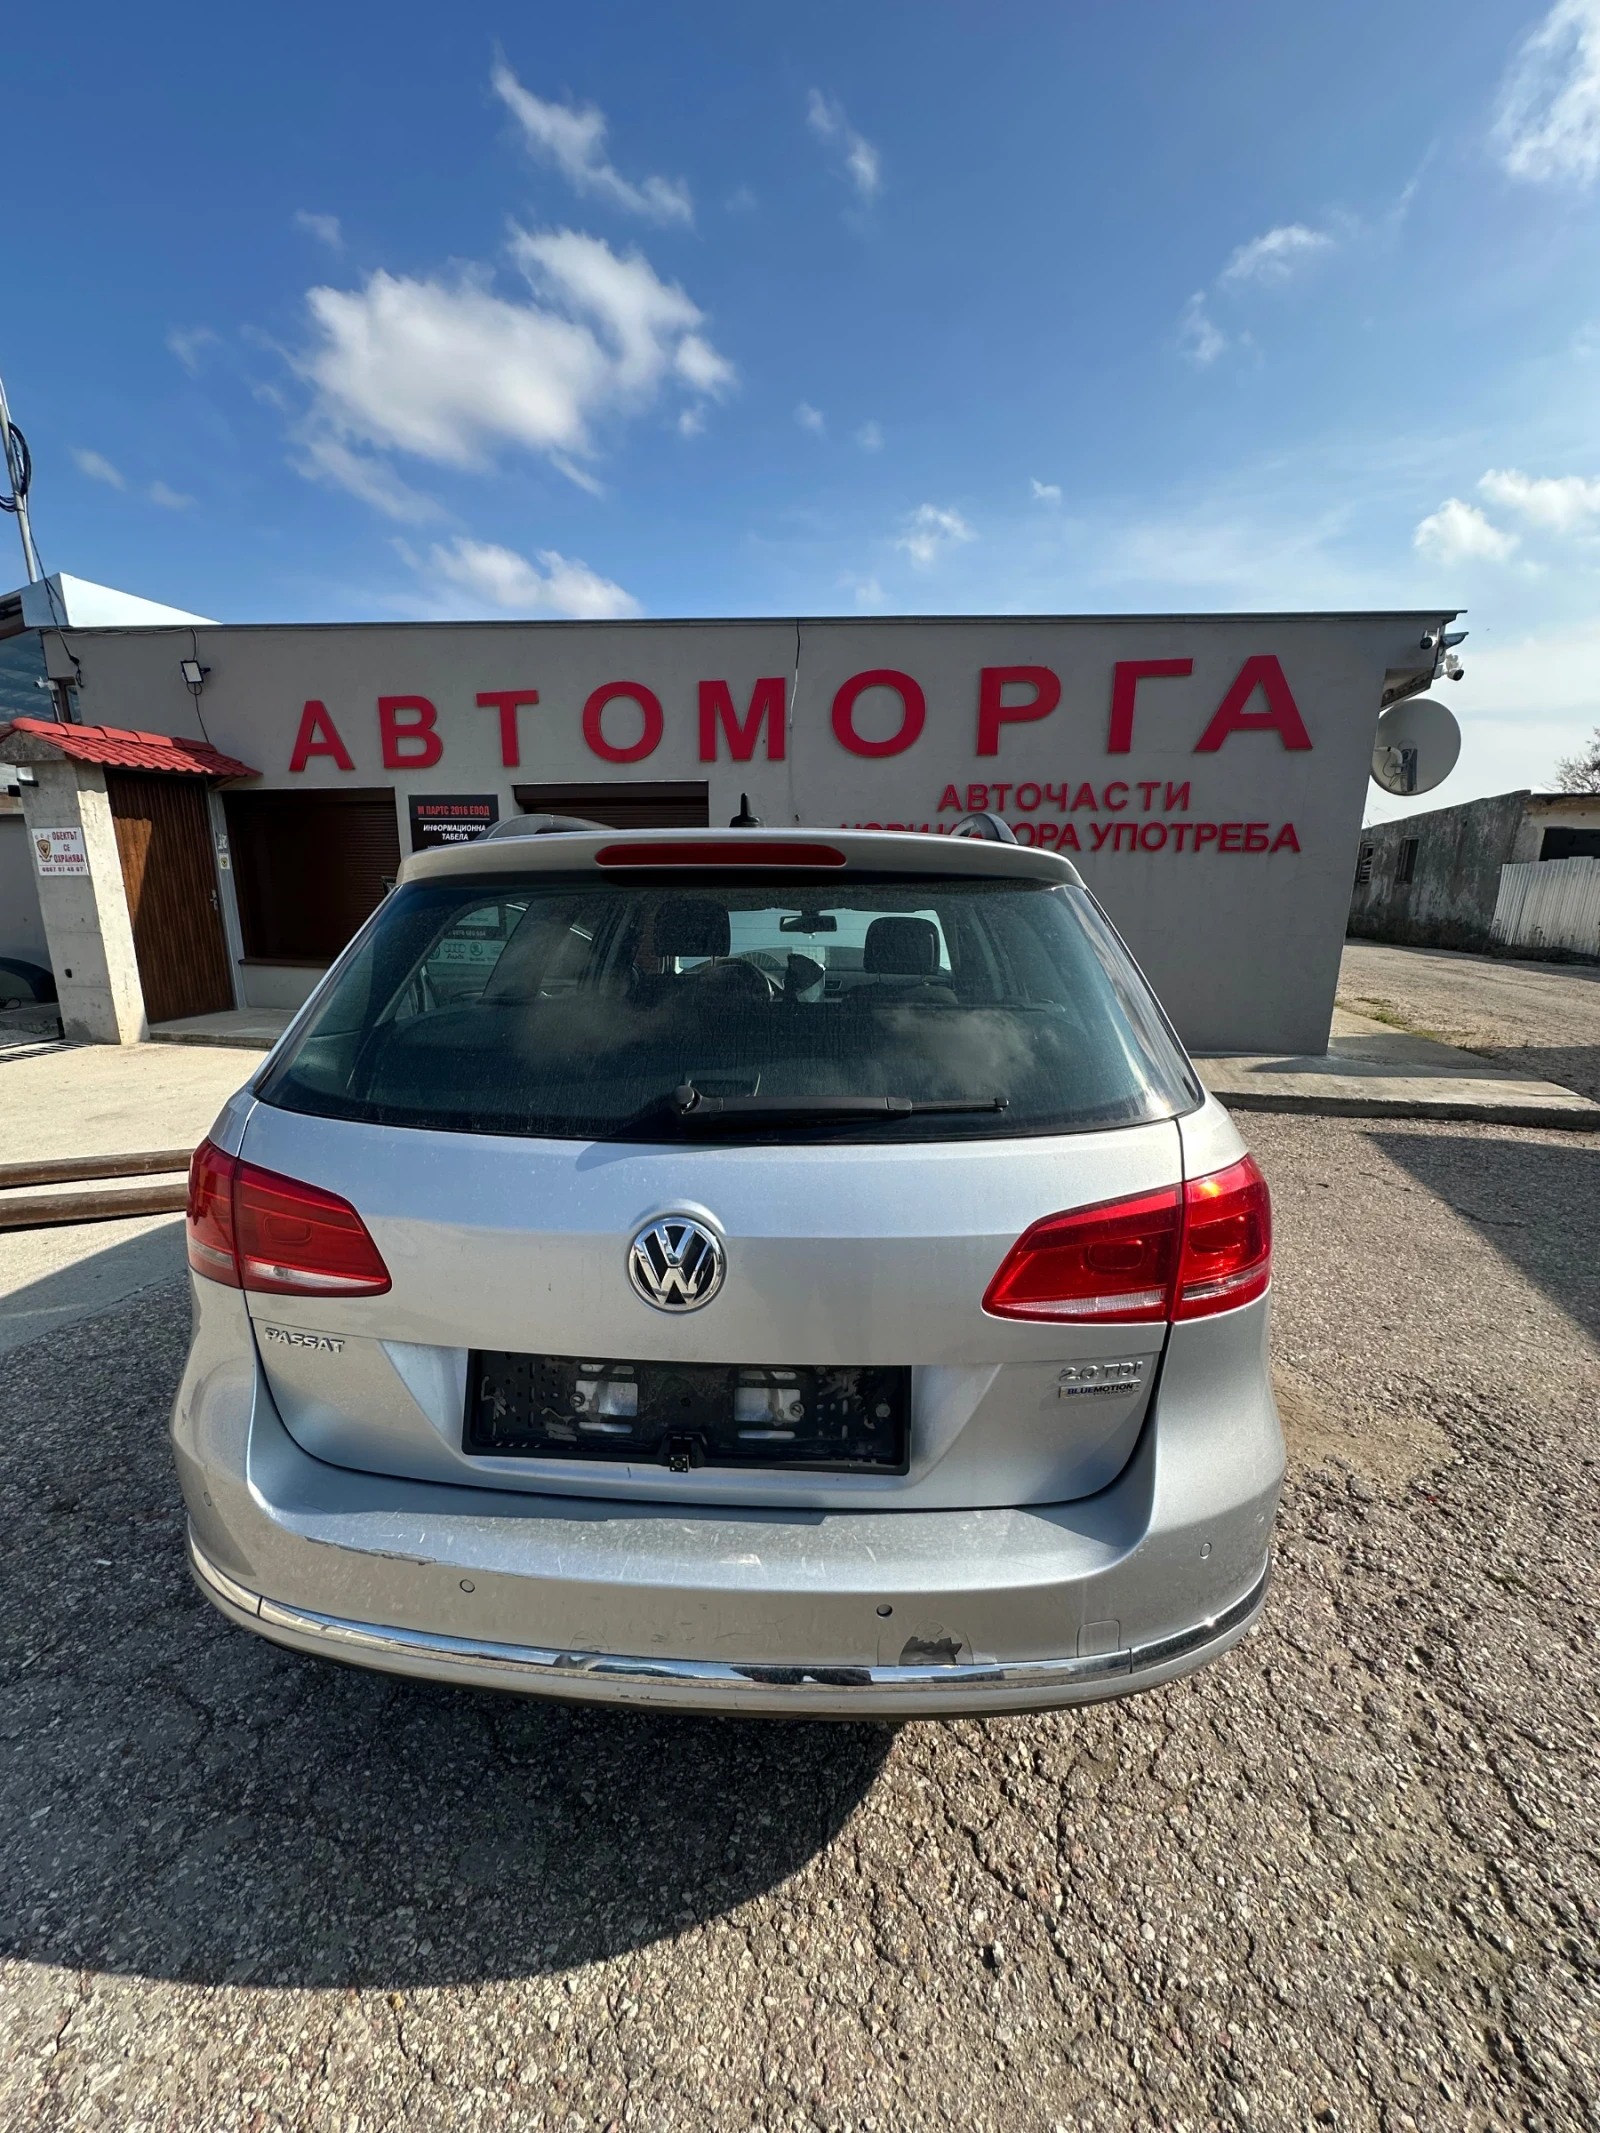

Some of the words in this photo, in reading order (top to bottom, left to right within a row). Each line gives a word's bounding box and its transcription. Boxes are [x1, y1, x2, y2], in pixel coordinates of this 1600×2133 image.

[289, 654, 1314, 772] АВТОМОРГА
[937, 781, 1191, 812] АВТОЧАСТИ
[417, 805, 425, 815] М
[426, 805, 449, 815] ПАРТС
[450, 805, 468, 815] 2016
[469, 805, 490, 816] ЕООД
[423, 824, 486, 833] ИНФОРМАЦИОННА
[52, 831, 77, 841] ОБЕКТЪТ
[442, 833, 469, 841] ТАБЕЛА
[1089, 821, 1302, 853] УПОТРЕБА
[53, 854, 84, 863] ОХРАНЯВА
[265, 1327, 345, 1353] PASSAT
[1102, 1361, 1143, 1379] TDI
[1067, 1383, 1134, 1395] BLUEMOTION
